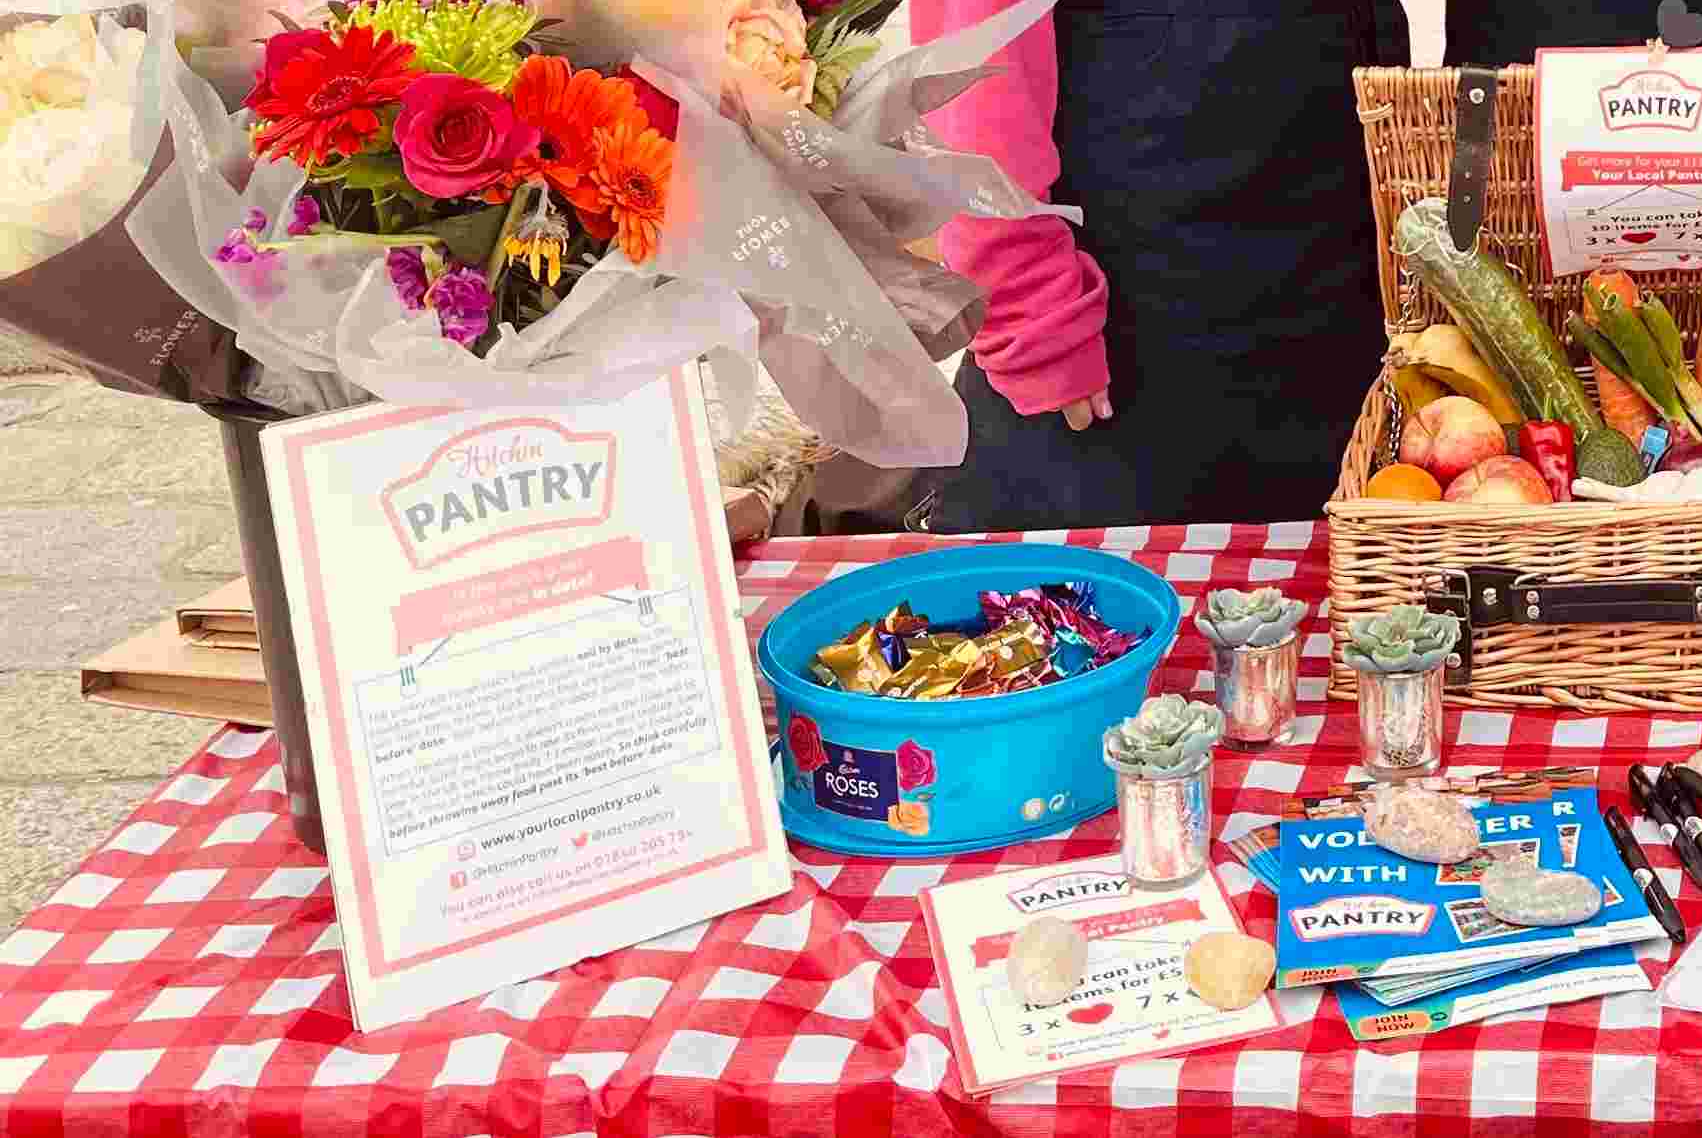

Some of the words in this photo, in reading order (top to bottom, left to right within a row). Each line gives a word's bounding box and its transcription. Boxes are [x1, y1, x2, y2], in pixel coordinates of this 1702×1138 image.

[1608, 96, 1697, 118] PANTRY
[786, 110, 830, 169] FLOWER
[1592, 169, 1625, 181] Your
[1628, 169, 1665, 181] Local
[1591, 224, 1610, 232] 10
[1613, 222, 1661, 231] items
[1665, 221, 1689, 230] for
[1610, 215, 1641, 223] You
[1646, 213, 1676, 222] can
[1585, 236, 1598, 246] 3
[1672, 231, 1687, 240] 7
[405, 460, 604, 543] PANTRY
[824, 772, 881, 799] ROSES
[480, 784, 663, 852] www.yourlocalpantry.co.uk
[1298, 815, 1534, 850] VOLER
[1298, 865, 1409, 884] WITH
[1020, 880, 1129, 907] PANTRY
[1301, 910, 1425, 931] PANTRY
[1091, 967, 1130, 983] can
[1135, 955, 1181, 973] take
[1119, 977, 1150, 991] for
[1158, 967, 1183, 982] £5
[1136, 994, 1153, 1010] 7
[1016, 1022, 1035, 1038] 3
[1375, 1023, 1417, 1034] NOW
